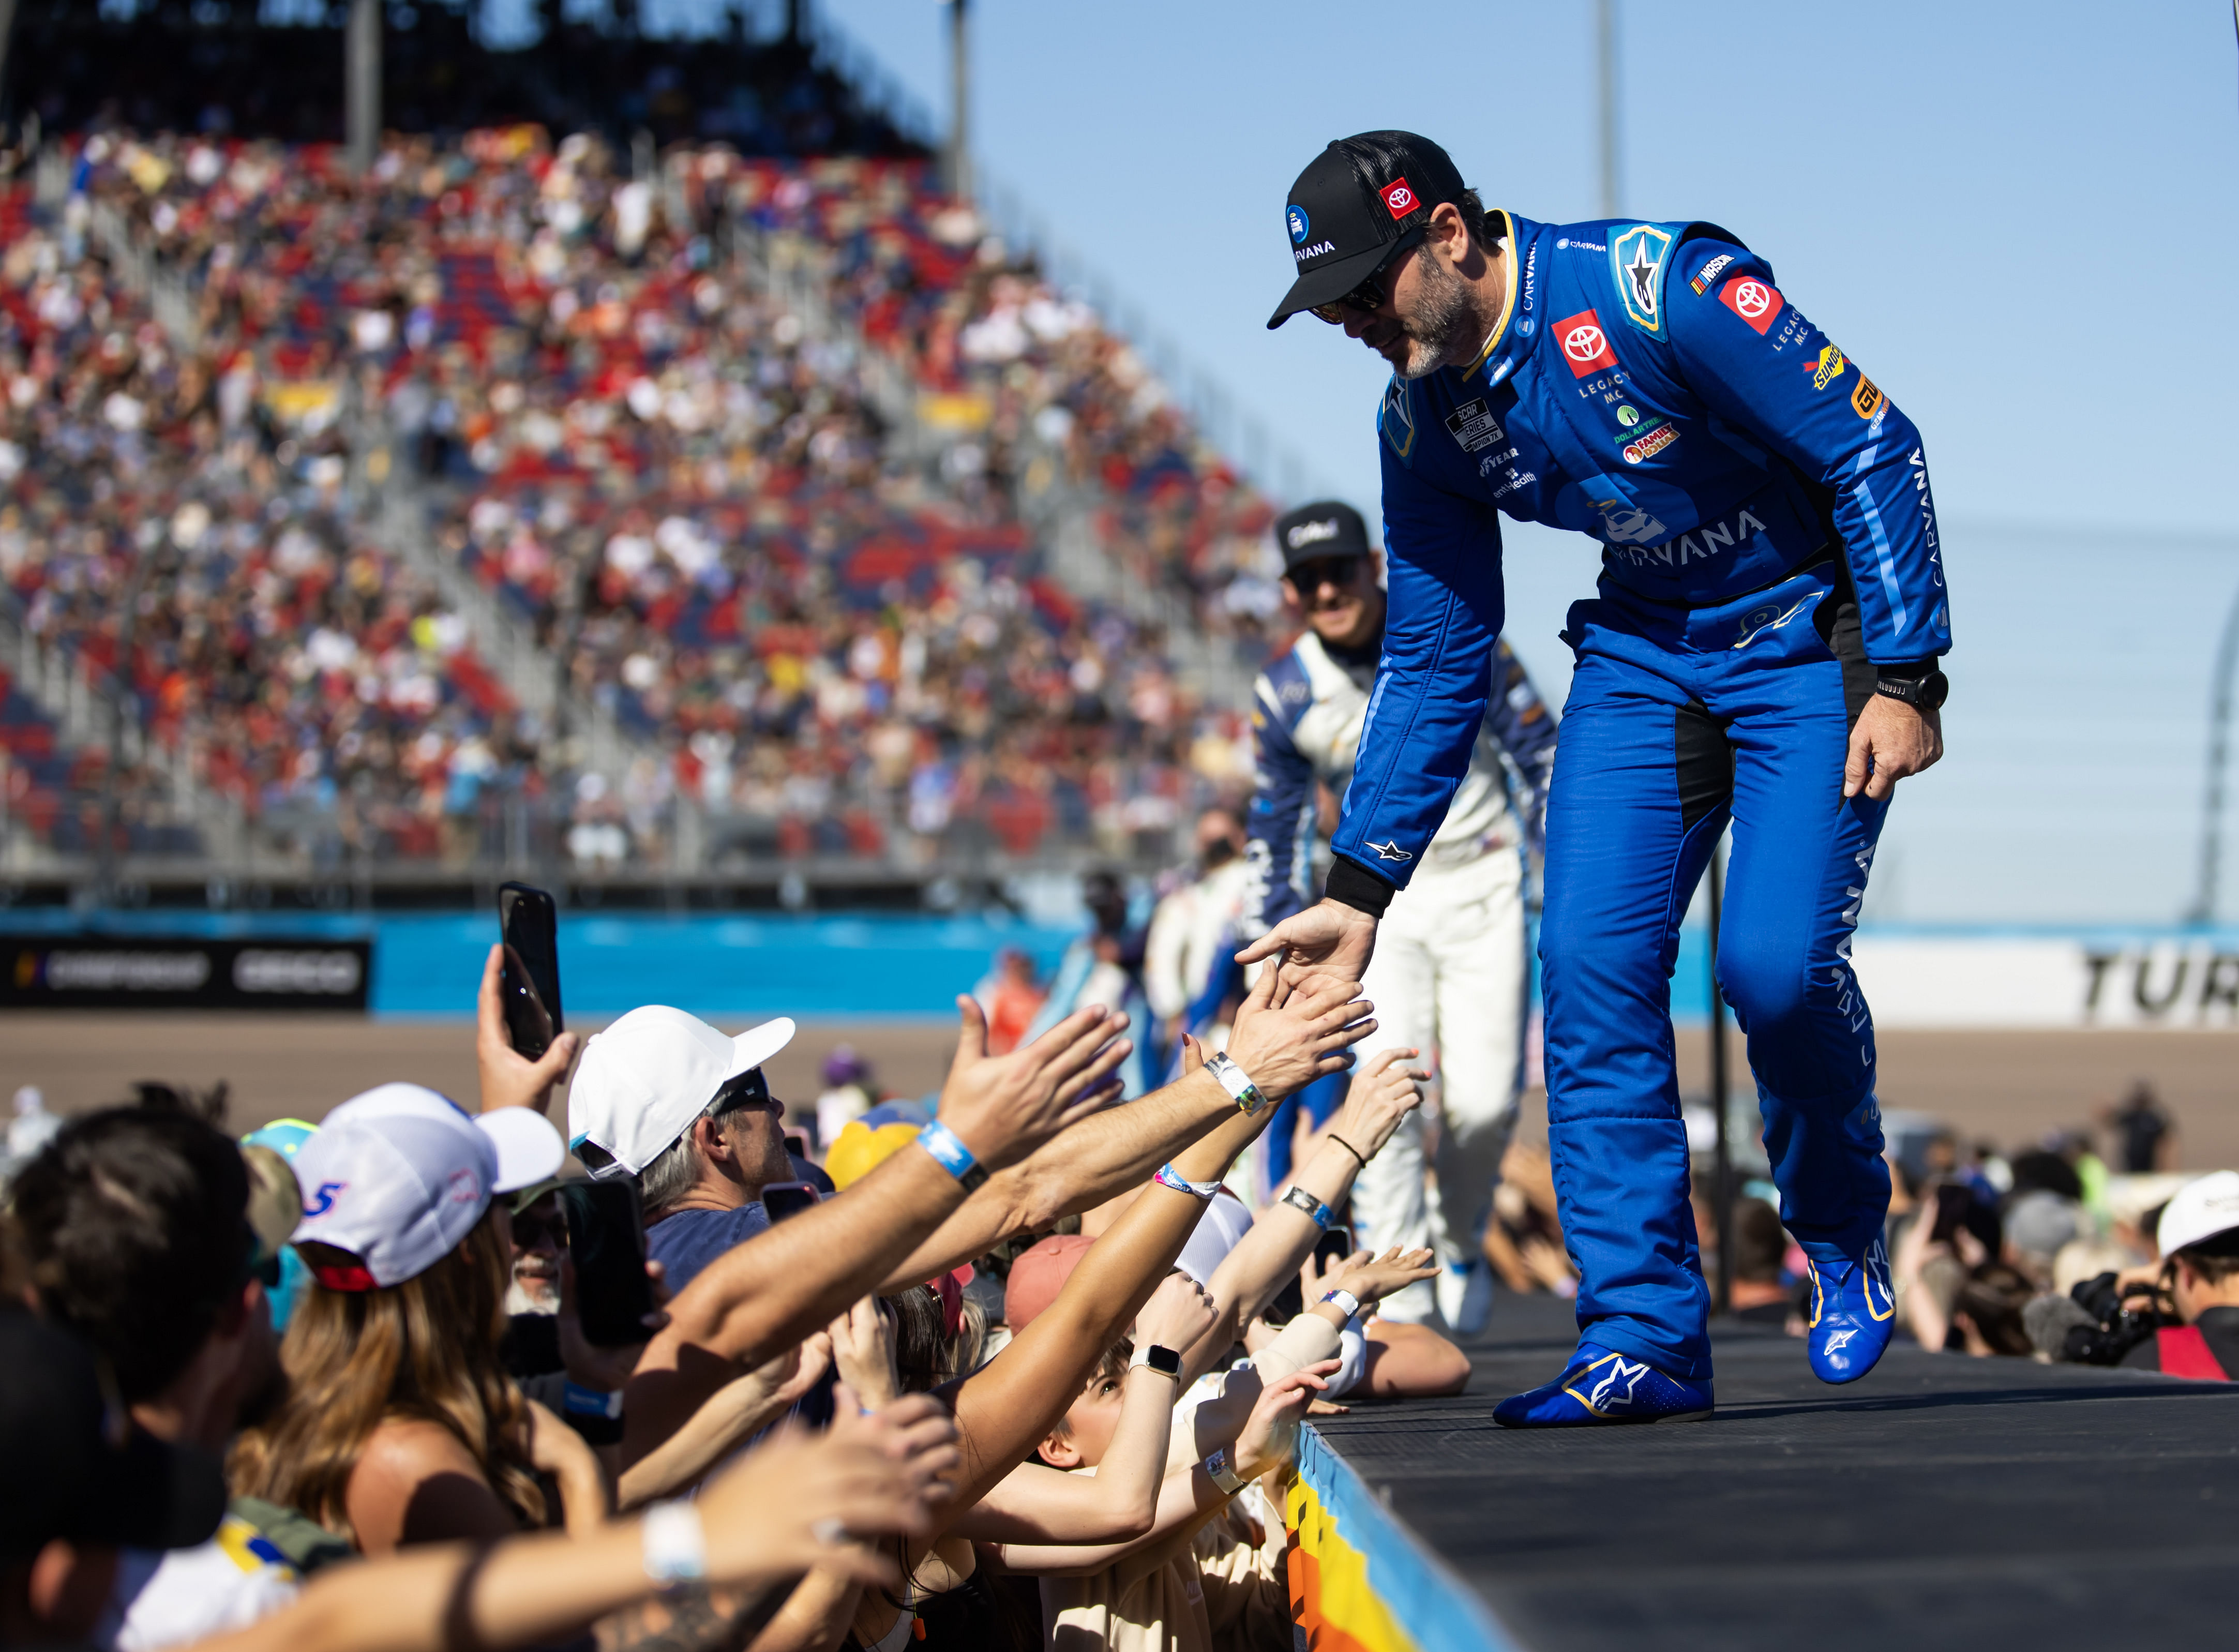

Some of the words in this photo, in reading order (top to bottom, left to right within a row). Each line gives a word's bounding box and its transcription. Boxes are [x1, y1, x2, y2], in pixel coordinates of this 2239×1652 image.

[1294, 240, 1335, 262] RVANA
[1570, 241, 1606, 252] CARVANA
[1523, 242, 1537, 310] CARVANA
[1700, 254, 1735, 283] NASCAR
[1579, 371, 1631, 398] LEGACY
[1636, 424, 1673, 449] FAMILY
[1643, 431, 1679, 457] DOLLAR
[1909, 446, 1943, 587] CARVANA
